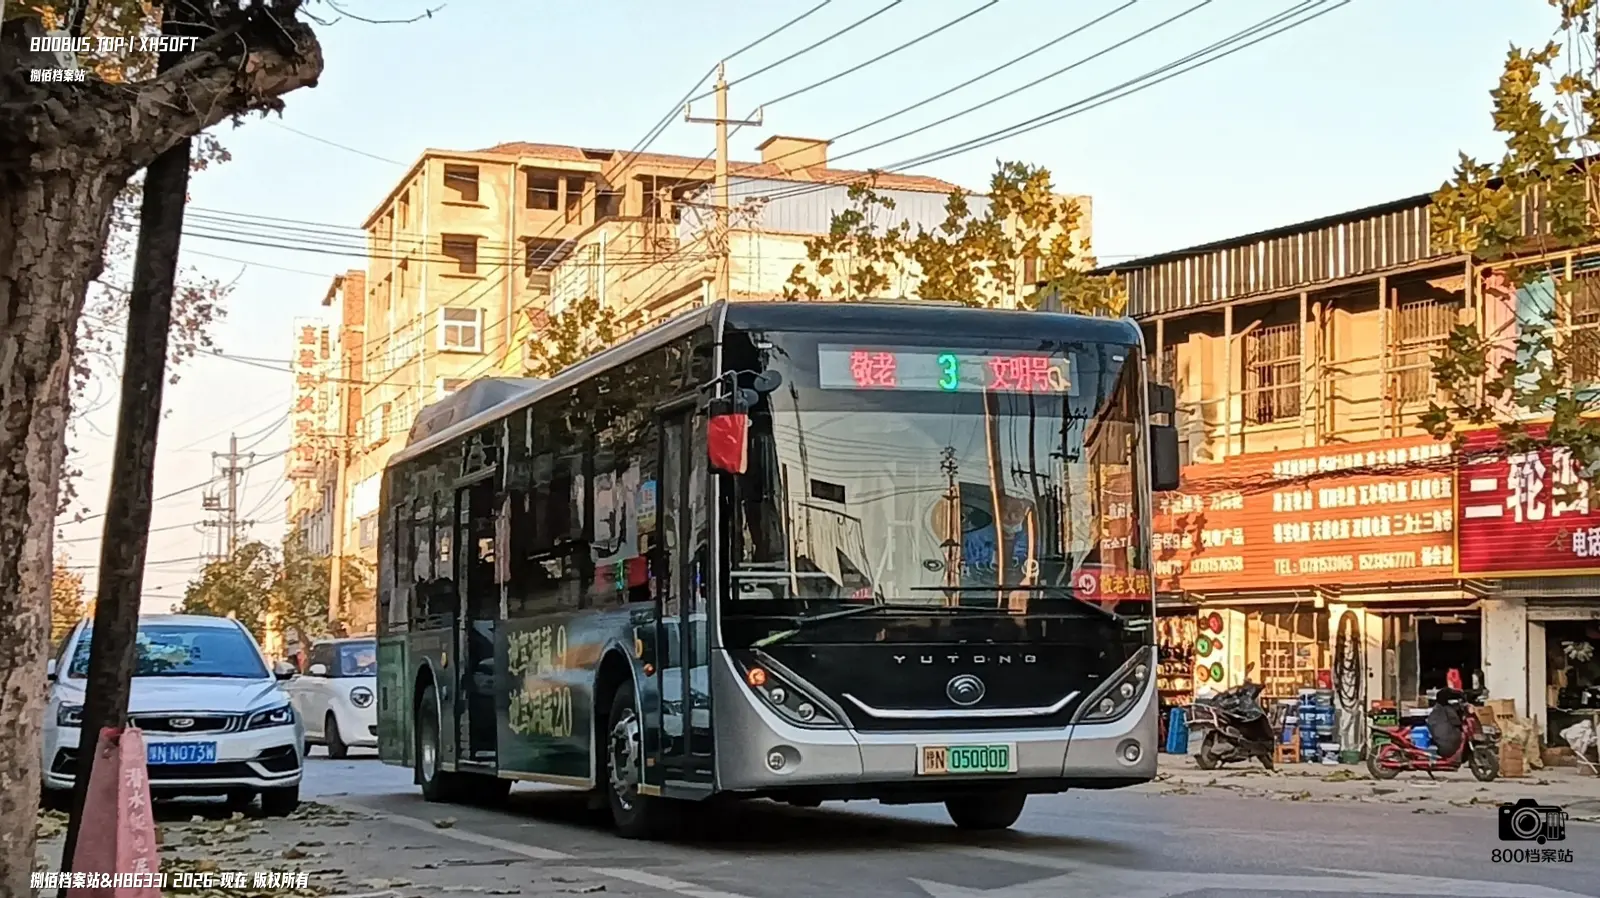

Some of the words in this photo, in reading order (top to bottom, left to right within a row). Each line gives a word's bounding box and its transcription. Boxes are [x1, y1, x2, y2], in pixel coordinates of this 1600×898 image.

[850, 350, 897, 388] 敬老
[936, 351, 961, 392] 3
[893, 655, 1037, 664] YUTONG
